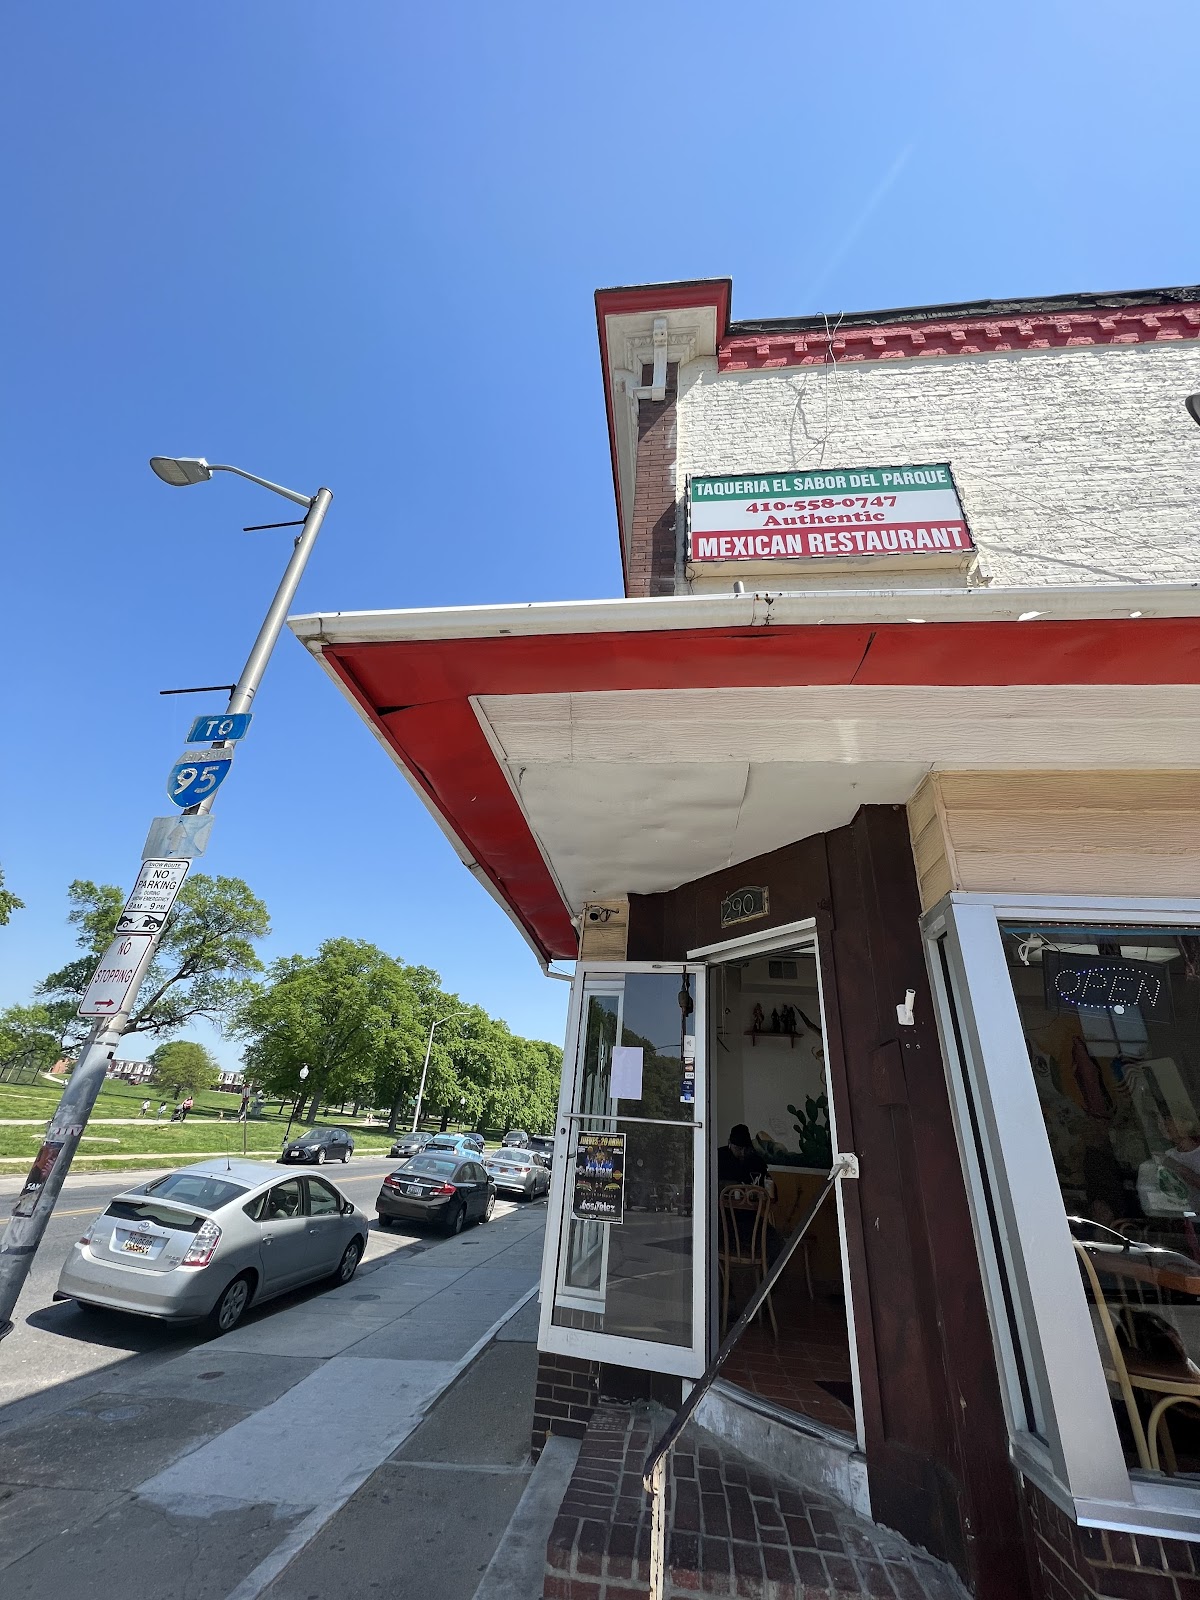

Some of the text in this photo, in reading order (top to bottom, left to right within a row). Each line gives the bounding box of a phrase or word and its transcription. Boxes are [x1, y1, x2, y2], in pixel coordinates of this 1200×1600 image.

[696, 470, 948, 496] TAQUERIA EL SABOR DEL PARQUE
[746, 495, 897, 513] 410-558-0747
[763, 511, 885, 527] Authentic
[698, 527, 963, 557] MEXICAN RESTAURANT
[205, 718, 234, 737] TO
[174, 765, 220, 795] 95
[152, 869, 170, 879] NO
[136, 880, 177, 890] PARKING
[117, 940, 132, 956] NO
[94, 969, 133, 984] STOPPING
[1054, 967, 1161, 1008] OPEN
